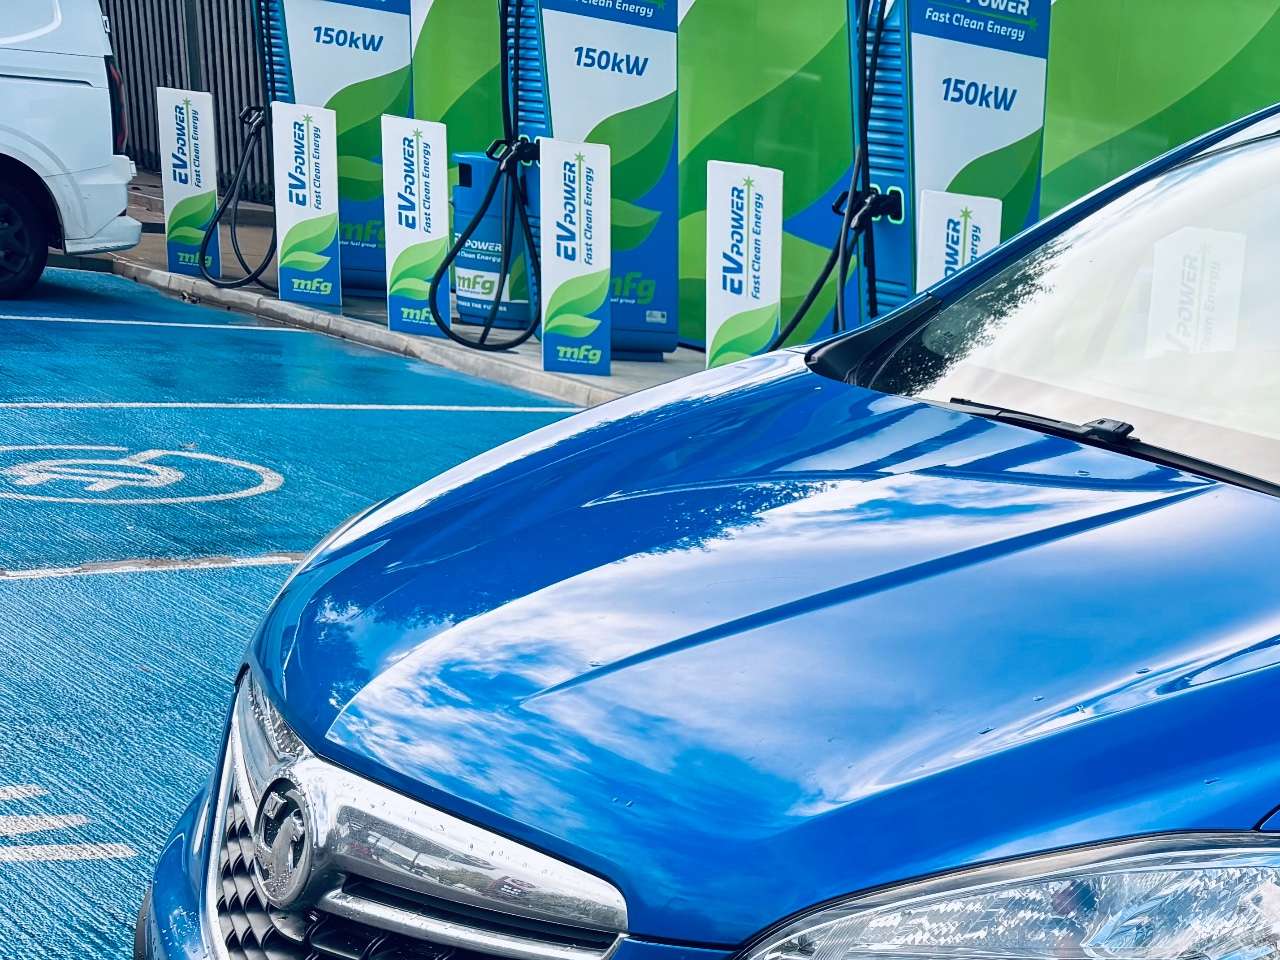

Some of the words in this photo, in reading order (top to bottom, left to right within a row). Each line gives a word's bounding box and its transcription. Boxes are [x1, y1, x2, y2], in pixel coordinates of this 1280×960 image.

[313, 26, 384, 52] 150kW
[925, 8, 950, 24] Fast
[952, 14, 985, 31] Clean
[986, 20, 1026, 41] Energy
[574, 46, 649, 76] 150kW
[942, 77, 1018, 111] 150kW
[191, 109, 200, 139] Energy
[193, 143, 201, 170] Clean
[313, 127, 322, 161] Energy
[313, 162, 322, 189] Clean
[422, 142, 431, 182] Energy
[194, 169, 202, 188] Fast
[583, 167, 594, 209] Energy
[313, 190, 322, 210] Fast
[422, 183, 431, 212] Clean
[423, 212, 432, 233] Fast
[584, 211, 594, 240] Clean
[753, 193, 764, 236] Energy
[584, 241, 593, 265] Fast
[751, 237, 762, 275] Clean
[751, 276, 761, 300] Fast
